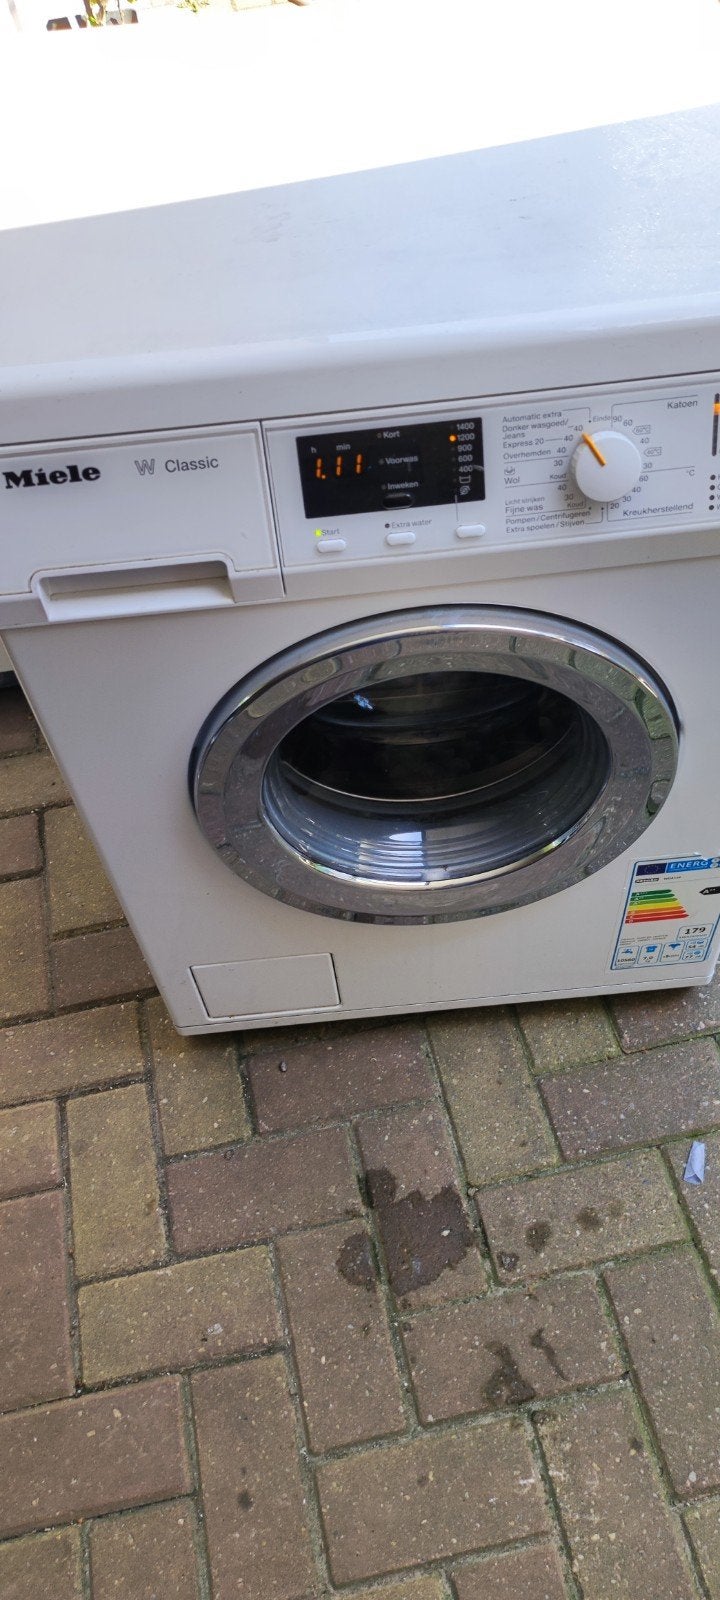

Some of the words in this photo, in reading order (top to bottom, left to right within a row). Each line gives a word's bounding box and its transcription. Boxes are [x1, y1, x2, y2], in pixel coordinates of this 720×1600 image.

[668, 400, 698, 409] Katoen
[502, 413, 540, 422] Automatic
[456, 422, 474, 430] 1400
[502, 424, 529, 432] Donker
[531, 418, 568, 429] wasgoed/
[503, 440, 533, 448] Express
[503, 449, 551, 460] Overhemden
[385, 455, 418, 464] Voorwas
[134, 458, 156, 476] W
[164, 456, 219, 473] Classic
[2, 465, 100, 489] Miele
[387, 481, 418, 490] Inweken
[505, 506, 525, 514] Fijne
[622, 502, 694, 516] Kreukherstellend
[412, 519, 432, 528] water
